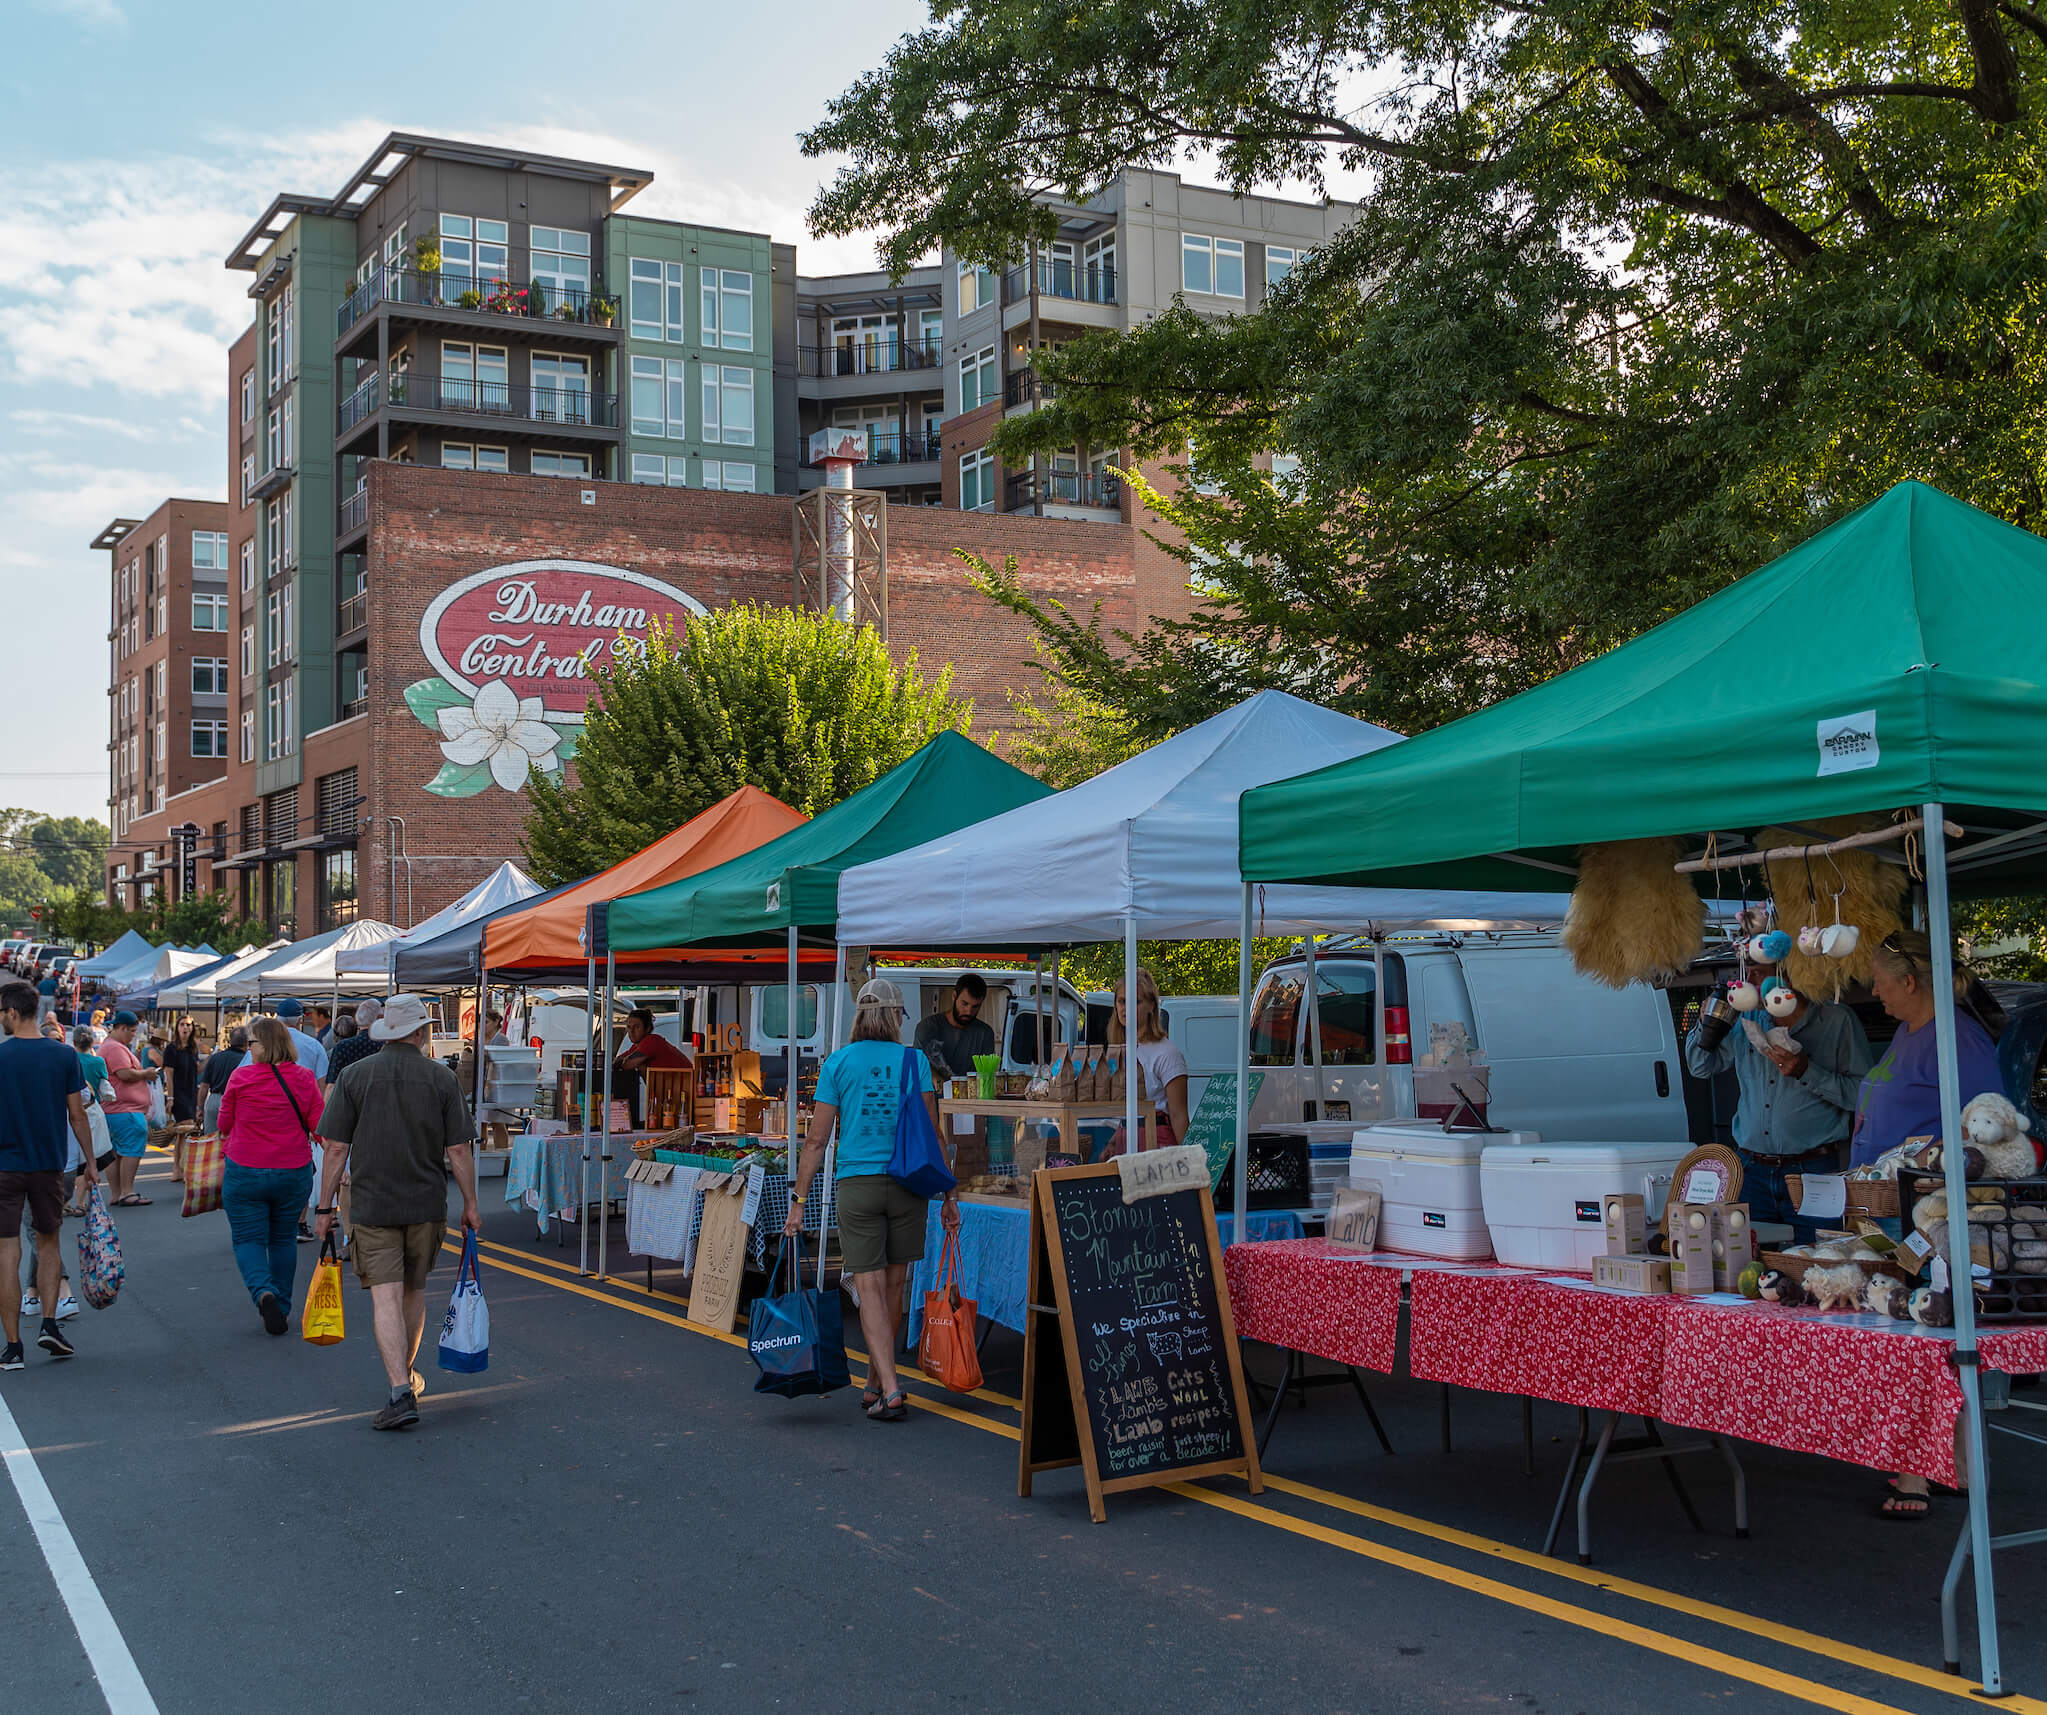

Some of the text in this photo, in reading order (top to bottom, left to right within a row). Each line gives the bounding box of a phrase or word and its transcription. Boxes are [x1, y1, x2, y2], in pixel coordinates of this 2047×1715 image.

[488, 580, 649, 630] Durham
[459, 632, 604, 680] Central
[706, 1022, 743, 1053] HG
[1134, 1158, 1190, 1185] LAMB
[1063, 1200, 1160, 1249] Stoney
[1332, 1193, 1376, 1245] Lamb
[1086, 1237, 1171, 1285] Mountain
[1134, 1272, 1179, 1305] Farm
[1091, 1321, 1115, 1337] We
[1188, 1310, 1206, 1320] in
[1182, 1326, 1208, 1338] Sheep
[751, 1334, 801, 1353] Spectrum
[1088, 1338, 1113, 1373] all
[1187, 1343, 1213, 1356] Lamb
[1167, 1369, 1205, 1390] Cuts
[1113, 1406, 1220, 1443] Lamb recipes
[1108, 1446, 1135, 1459] been
[1110, 1459, 1127, 1471] for
[1128, 1452, 1154, 1468] over
